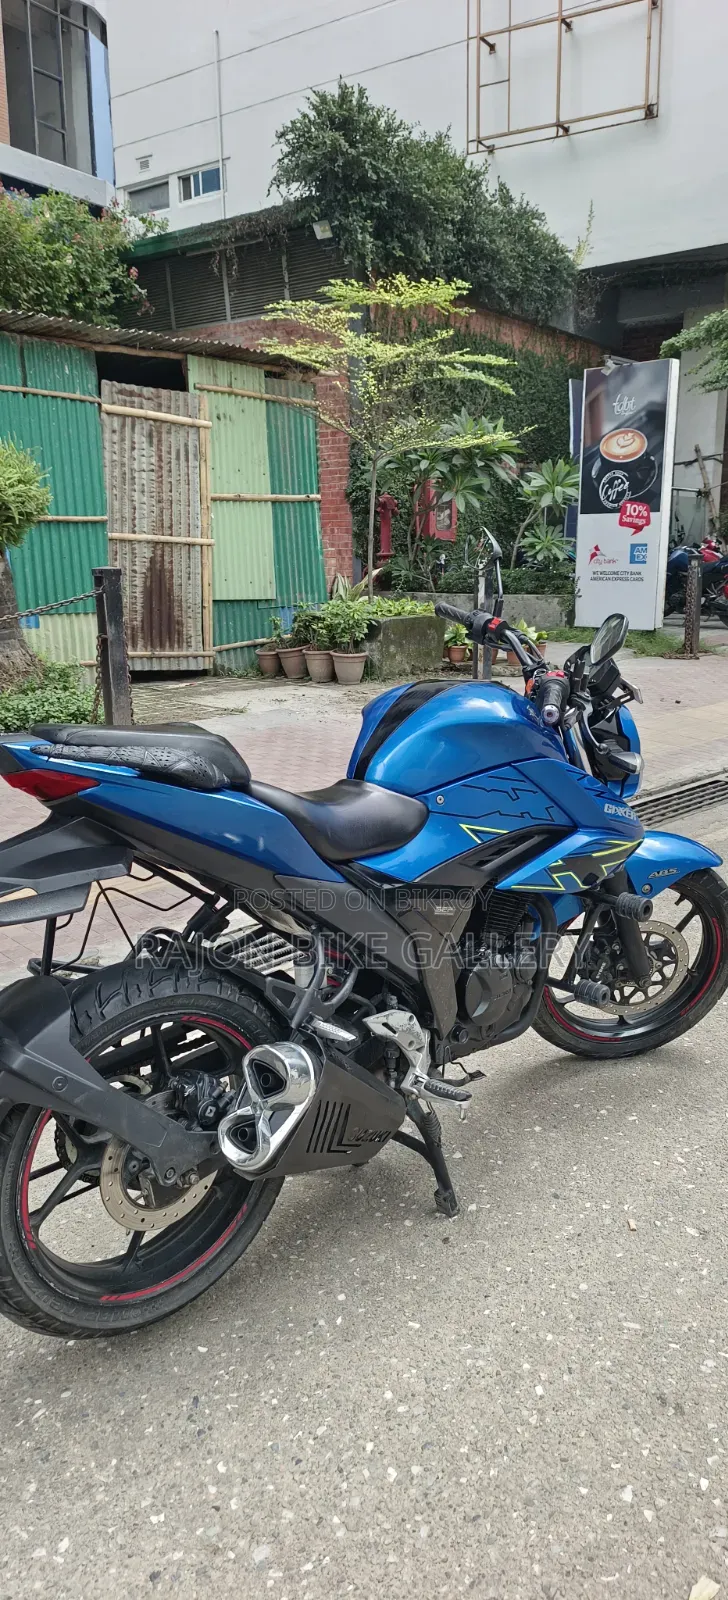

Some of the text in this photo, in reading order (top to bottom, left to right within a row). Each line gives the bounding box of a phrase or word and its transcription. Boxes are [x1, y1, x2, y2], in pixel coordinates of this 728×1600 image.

[601, 478, 630, 501] Coffee
[625, 503, 648, 517] 10%
[621, 514, 647, 526] Savings
[603, 803, 637, 821] GIXXER
[648, 867, 680, 880] ABS
